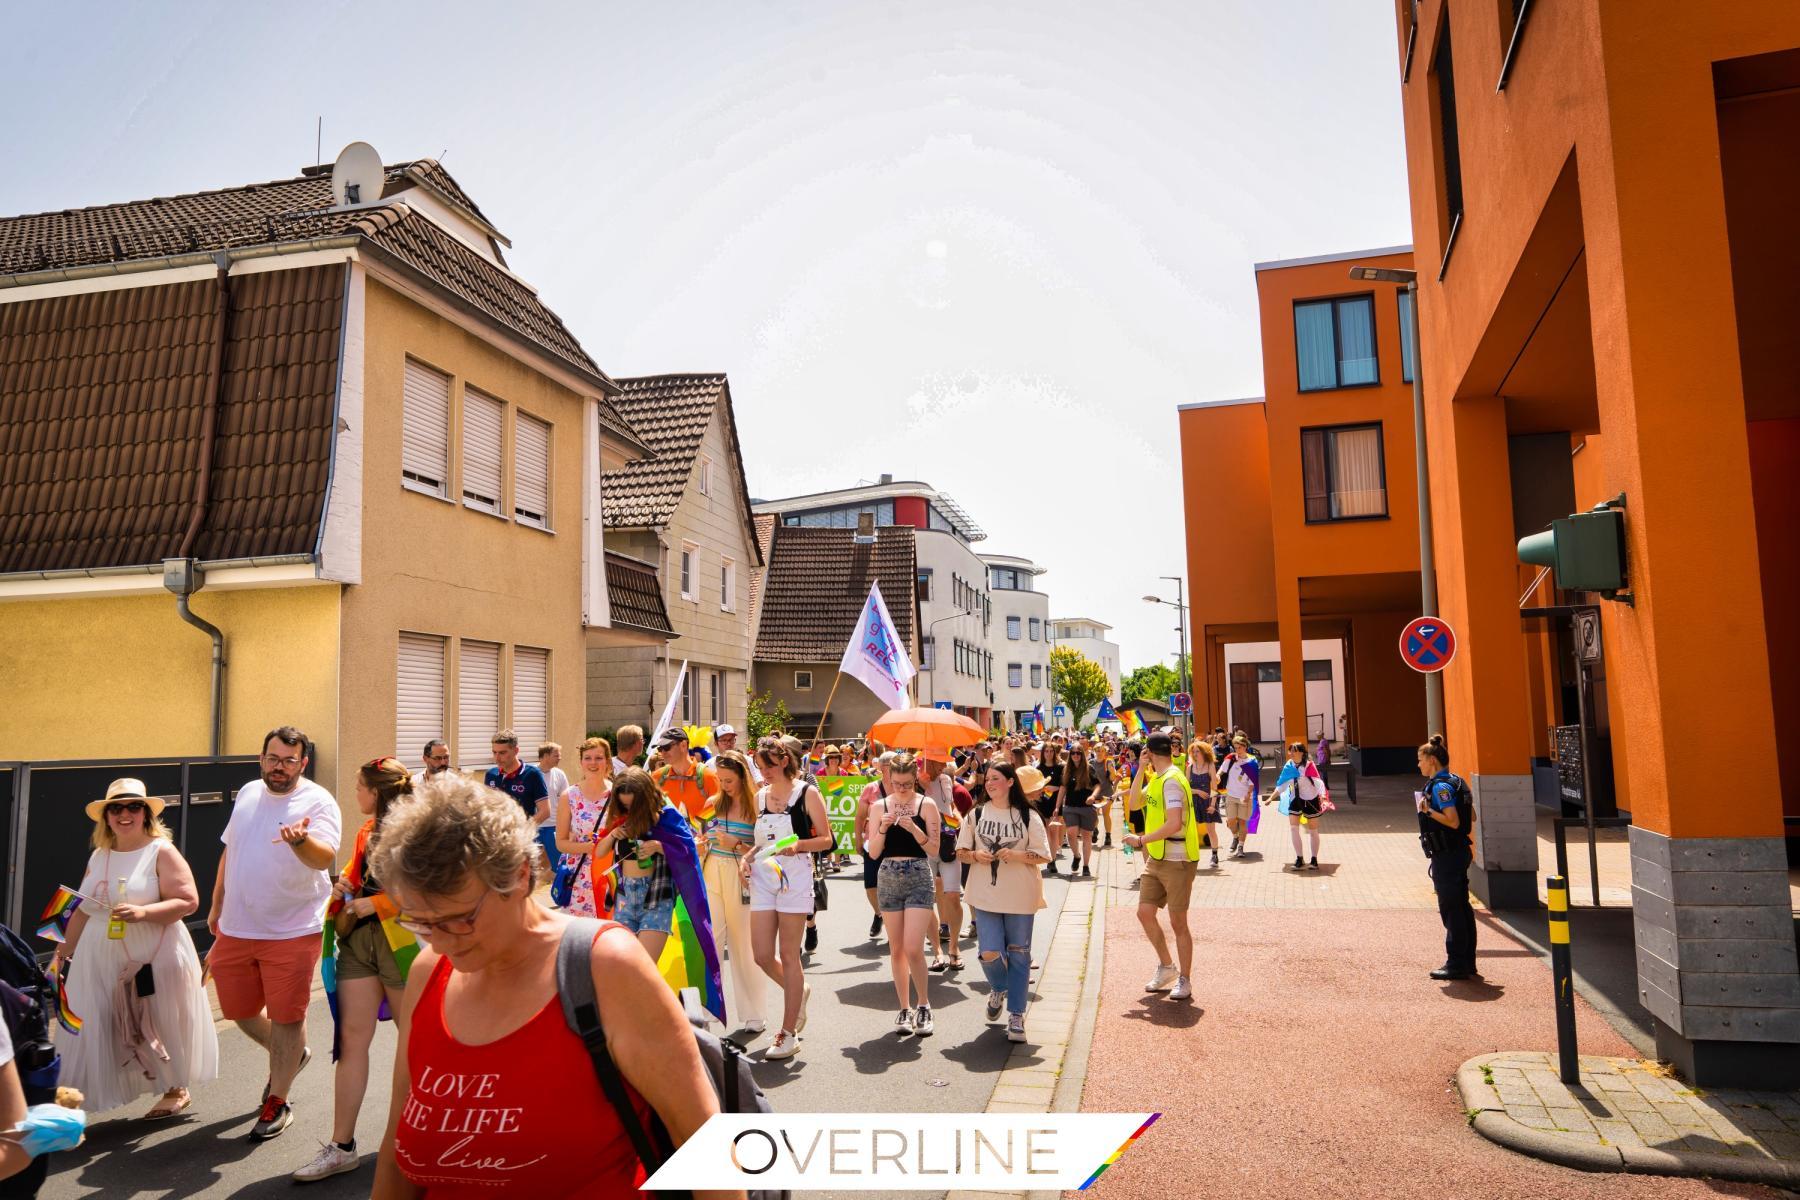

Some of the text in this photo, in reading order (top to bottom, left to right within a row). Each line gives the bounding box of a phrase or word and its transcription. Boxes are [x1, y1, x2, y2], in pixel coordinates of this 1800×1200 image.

[848, 784, 865, 793] SPR
[826, 796, 860, 815] LO
[828, 822, 845, 831] OT
[418, 1065, 500, 1099] LOVE
[403, 1092, 523, 1134] HE LIFE
[437, 1134, 548, 1170] live
